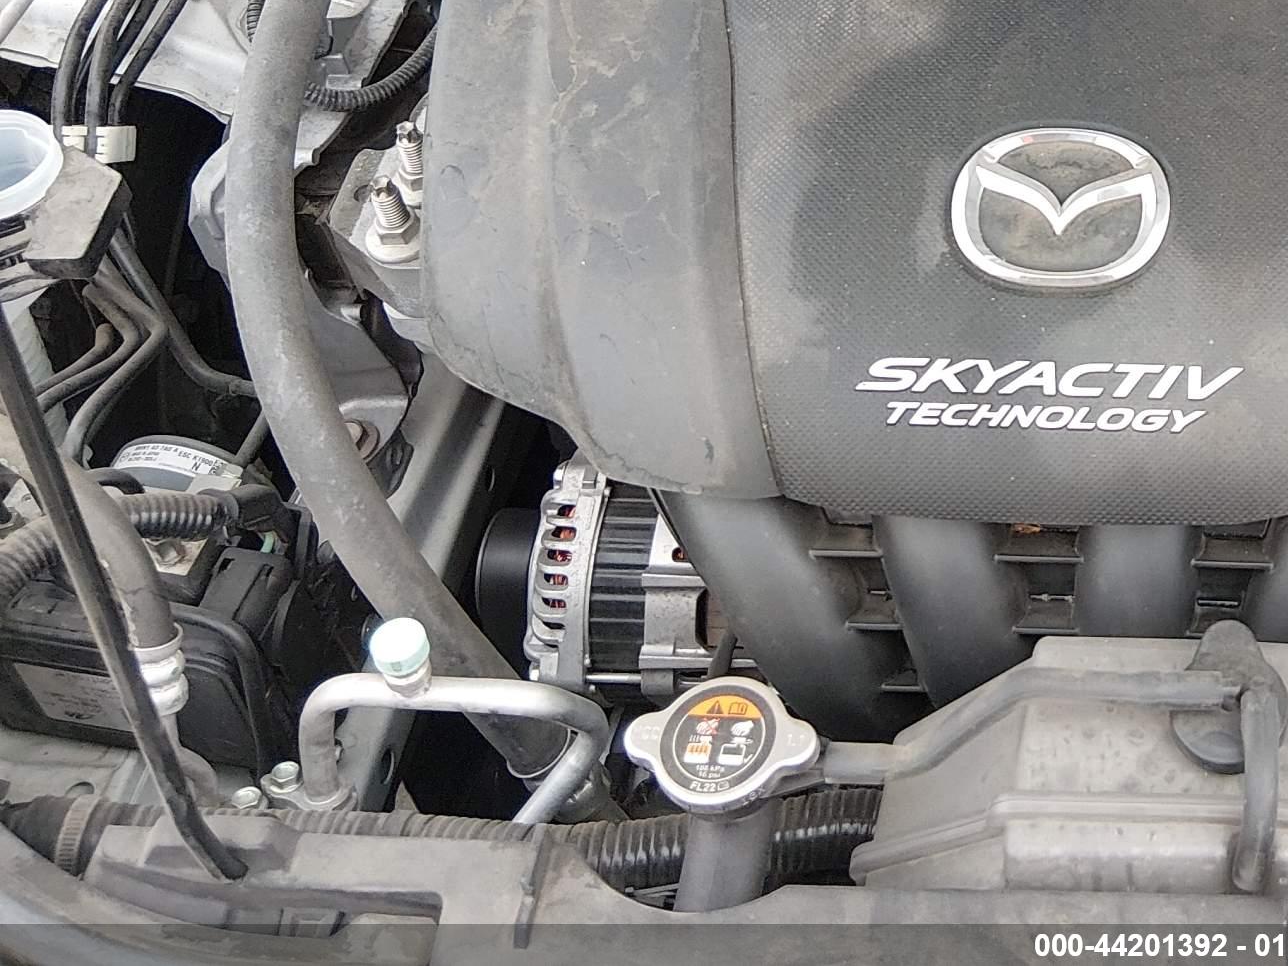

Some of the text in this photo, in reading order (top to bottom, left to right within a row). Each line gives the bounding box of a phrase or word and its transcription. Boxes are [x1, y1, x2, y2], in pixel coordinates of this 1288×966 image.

[853, 357, 1245, 401] SKYACTIV
[886, 401, 1207, 434] TECHNOLOGY
[689, 780, 717, 793] FL22
